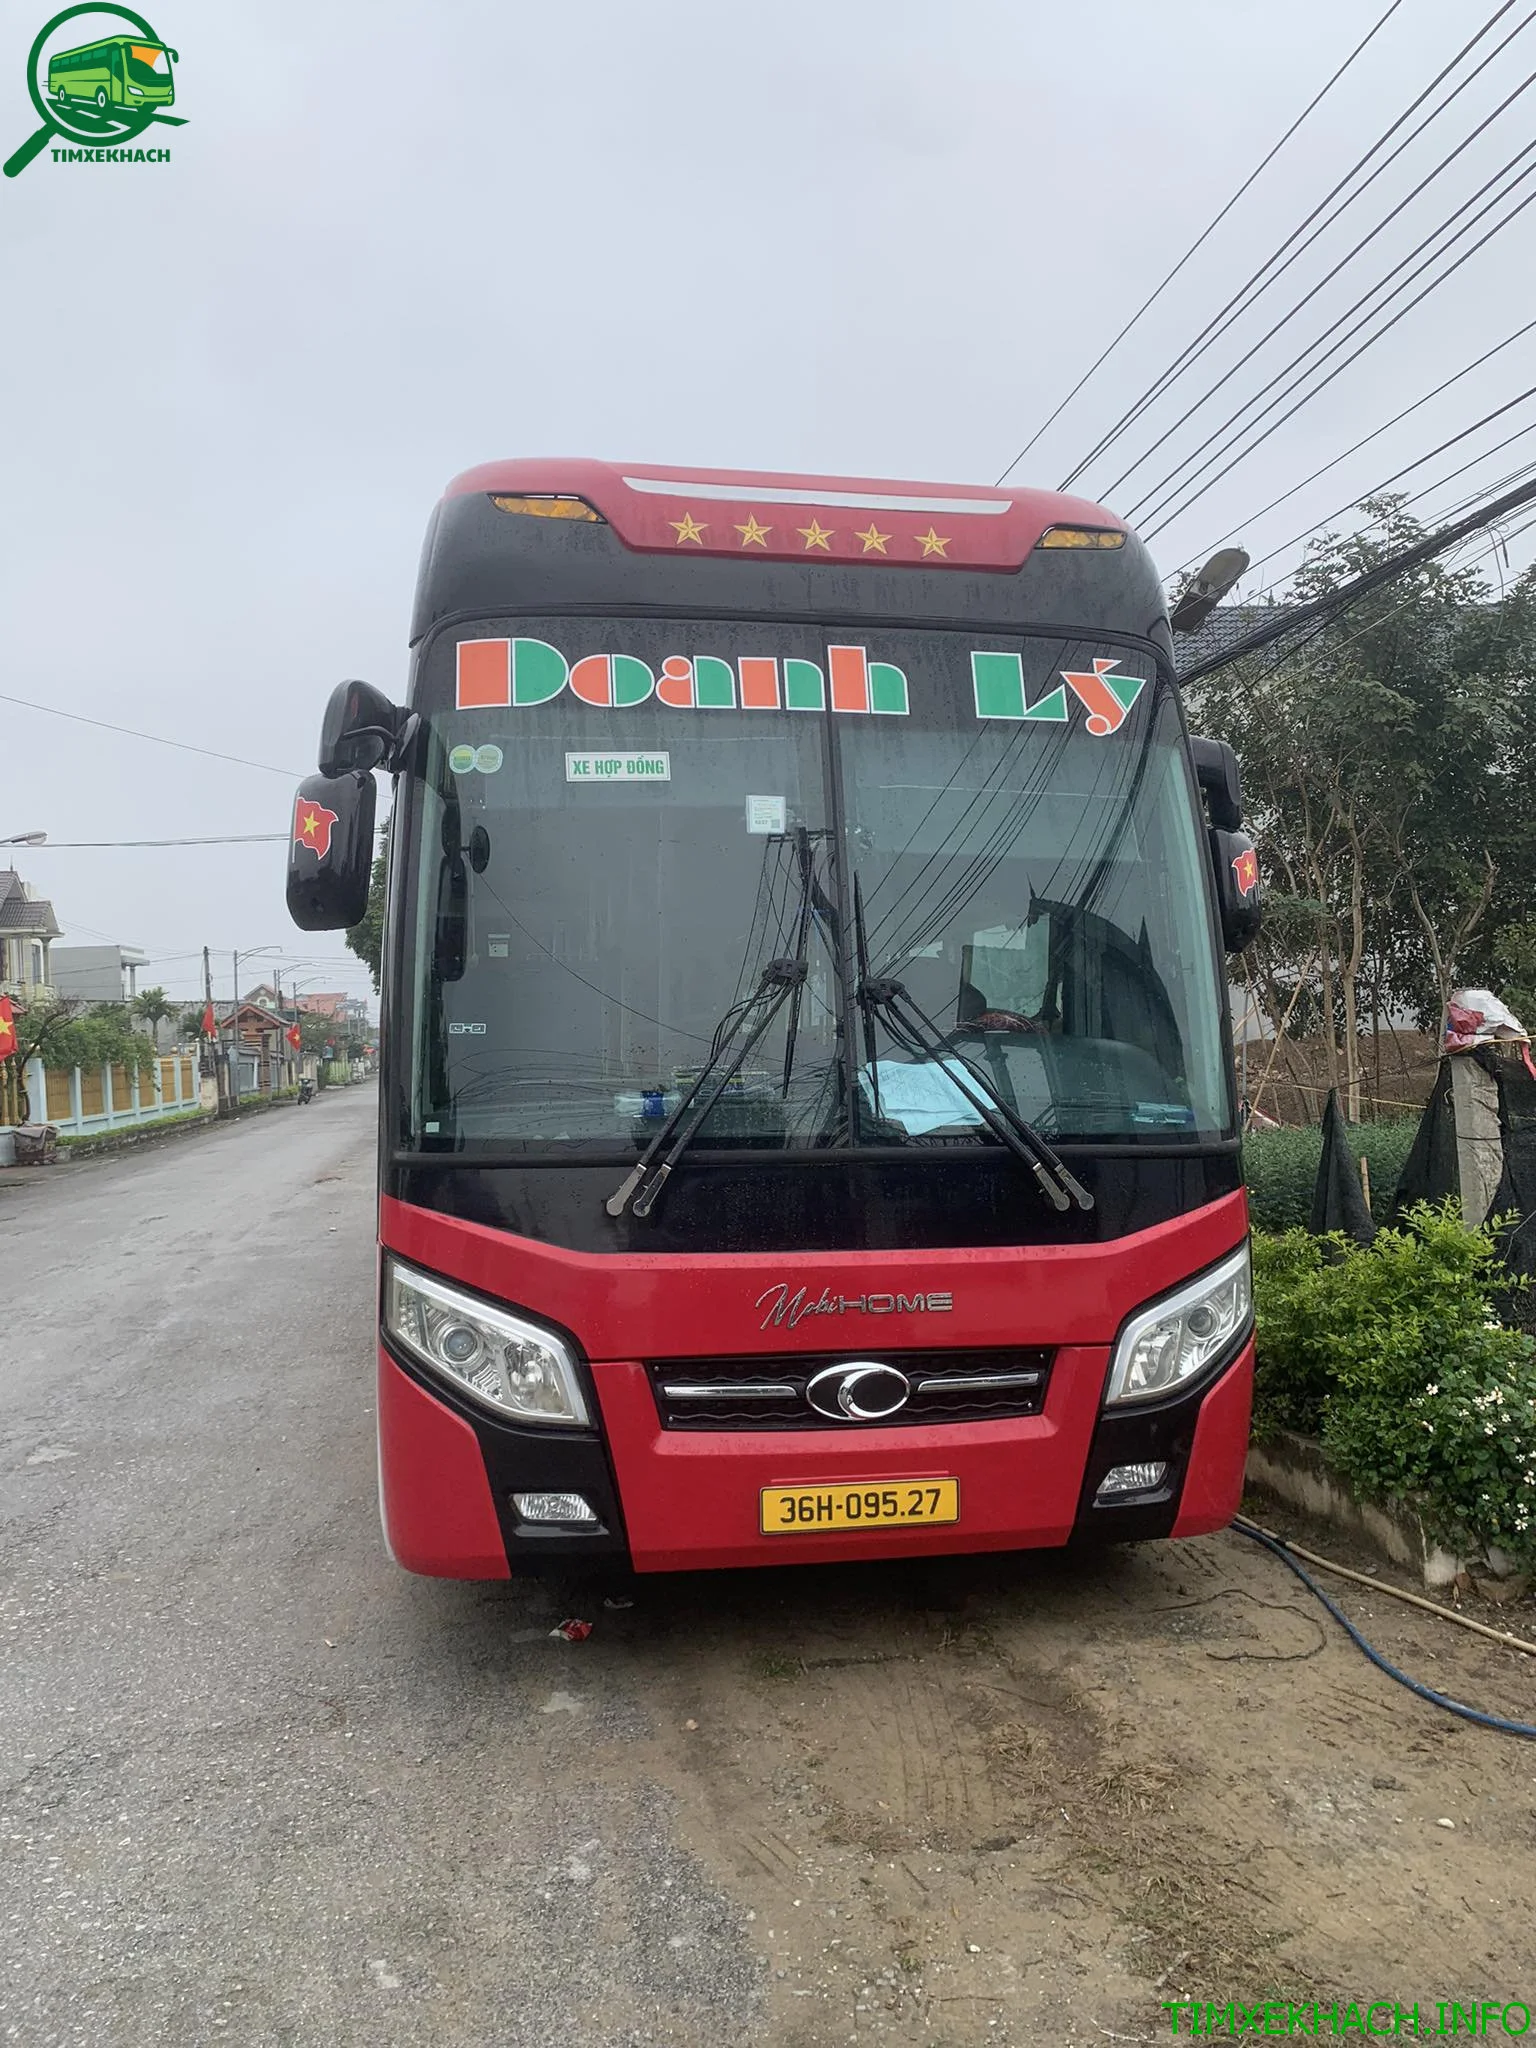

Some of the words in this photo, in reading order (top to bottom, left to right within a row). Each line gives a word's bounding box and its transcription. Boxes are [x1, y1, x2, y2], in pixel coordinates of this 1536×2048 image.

[456, 638, 910, 715] Doanh
[970, 651, 1147, 736] Lý
[573, 760, 590, 775] XE
[594, 759, 622, 777] HỢP
[626, 755, 665, 774] ĐỒNG
[779, 1488, 941, 1524] 36H-095.27
